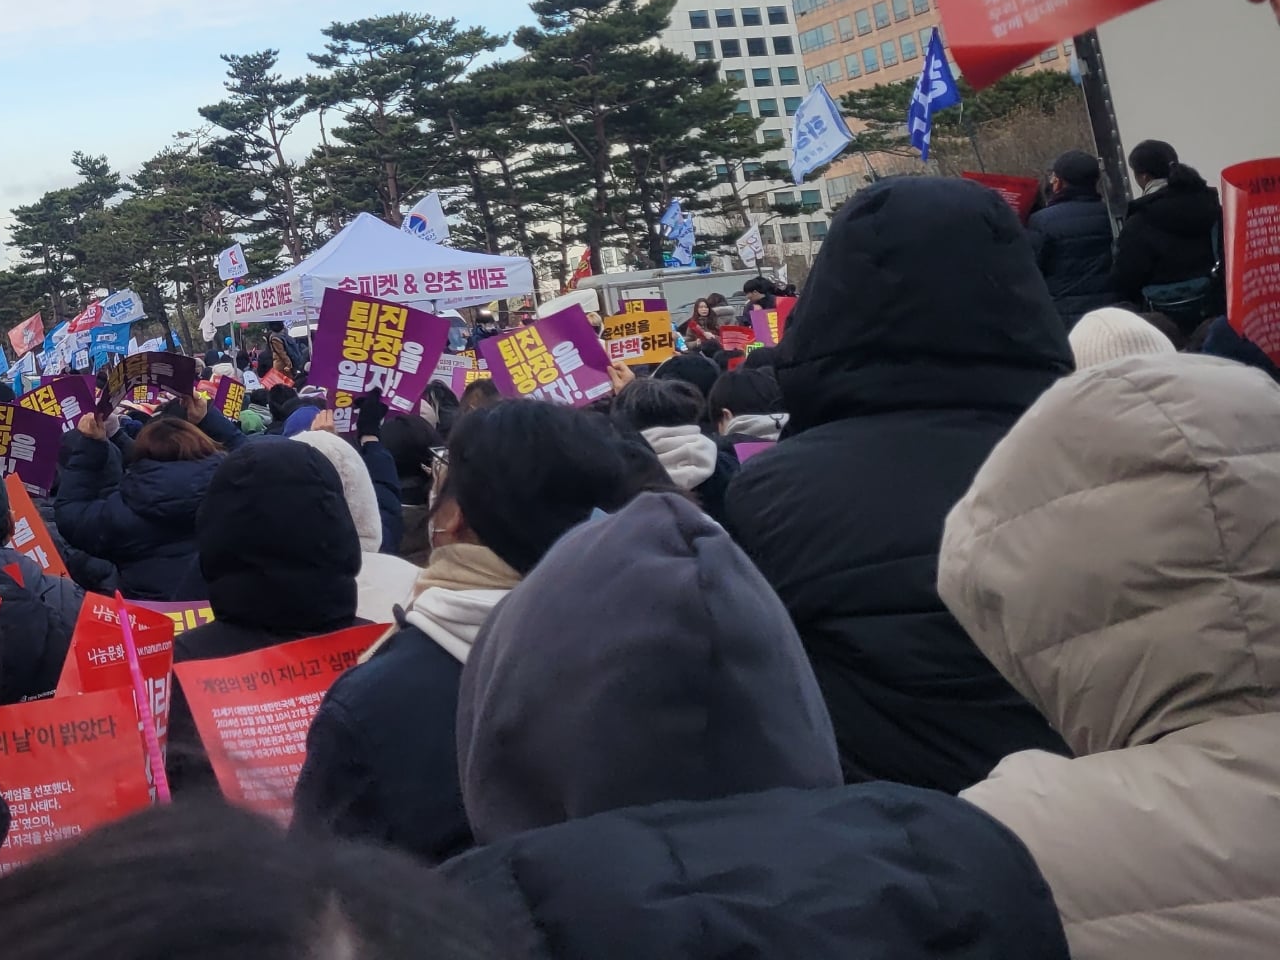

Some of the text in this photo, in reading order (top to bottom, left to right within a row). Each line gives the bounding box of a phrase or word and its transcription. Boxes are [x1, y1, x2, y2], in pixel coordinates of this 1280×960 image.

[338, 267, 509, 298] 손피켓 & 양초 배포
[235, 283, 292, 314] 손피켓 & 양초 배포
[345, 300, 409, 338] 퇴진
[603, 319, 650, 340] 윤석열을
[341, 328, 425, 375] 광장을
[497, 325, 547, 367] 퇴진
[610, 332, 673, 358] 탄핵하라
[508, 339, 585, 395] 광장을
[88, 643, 126, 665] 나눔문화
[278, 662, 323, 685] 지나고
[260, 698, 296, 712] 대한민국에
[275, 711, 291, 721] 10시
[291, 707, 308, 718] 27분
[10, 722, 60, 754] 날'이
[60, 715, 118, 748] 밝았다
[288, 719, 309, 731] 일이자
[0, 780, 75, 802] 계엄을 선포했다.
[29, 797, 62, 813] 사태다.
[13, 831, 41, 847] 자격을
